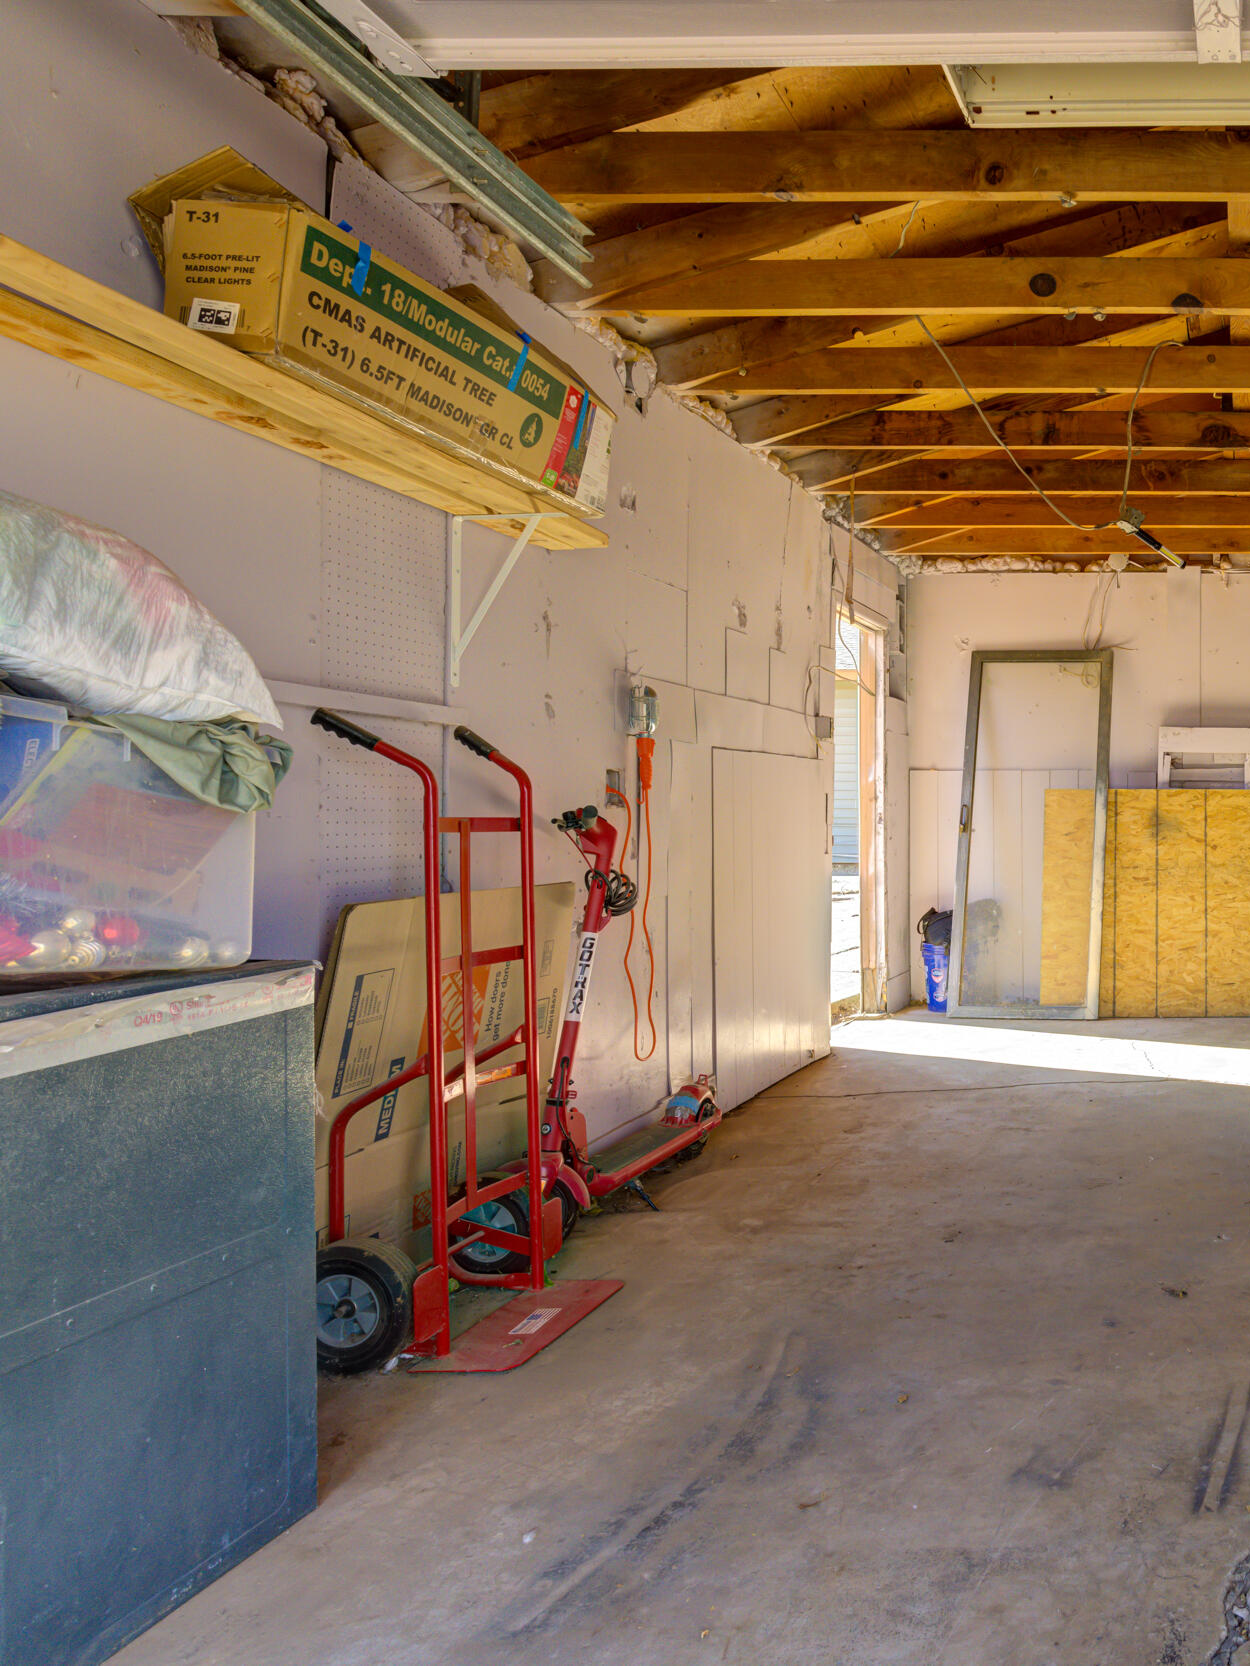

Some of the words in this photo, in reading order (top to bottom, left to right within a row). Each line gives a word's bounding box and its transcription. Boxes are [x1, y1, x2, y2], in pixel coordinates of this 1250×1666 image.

[186, 210, 220, 223] T-31
[182, 252, 224, 262] 6.5-FOOT
[225, 254, 261, 262] PRE-LIT
[233, 266, 256, 274] PINE
[185, 276, 216, 285] CLEAR
[217, 277, 252, 286] LIGHTS
[381, 282, 481, 357] 18/Modular
[307, 290, 366, 333] CMAS
[369, 326, 457, 386] ARTIFICIAL
[462, 377, 497, 407] TREE
[302, 326, 356, 370] (T-31)
[360, 356, 406, 391] 6.5FT
[480, 422, 499, 441] GR
[500, 433, 514, 450] CL
[569, 937, 596, 1015] GOTRAX
[485, 1006, 495, 1033] How
[492, 970, 502, 1003] doers
[496, 989, 506, 1021] more
[493, 1022, 502, 1042] get
[378, 1063, 402, 1135] MEDIM
